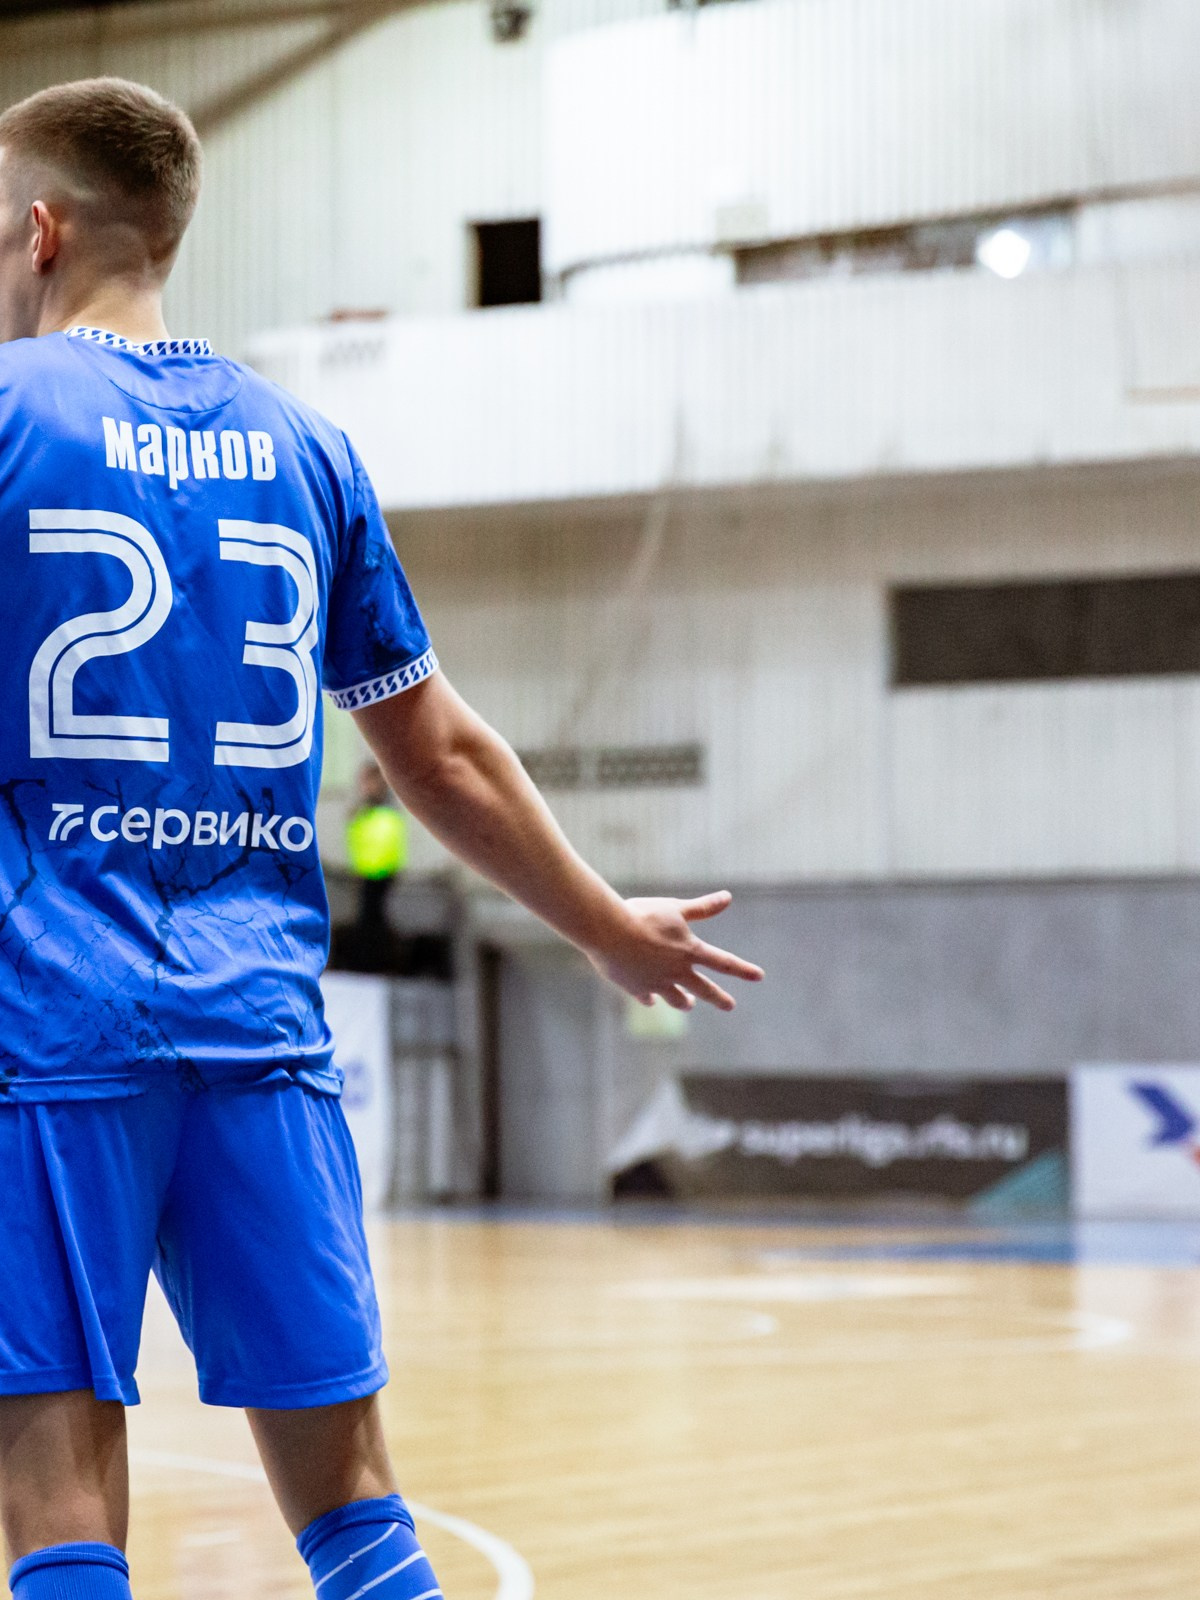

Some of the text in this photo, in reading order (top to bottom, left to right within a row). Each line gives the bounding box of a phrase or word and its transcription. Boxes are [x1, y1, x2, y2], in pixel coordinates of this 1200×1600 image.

[102, 416, 277, 491] Марков
[29, 508, 319, 769] 23
[90, 804, 314, 853] сервико
